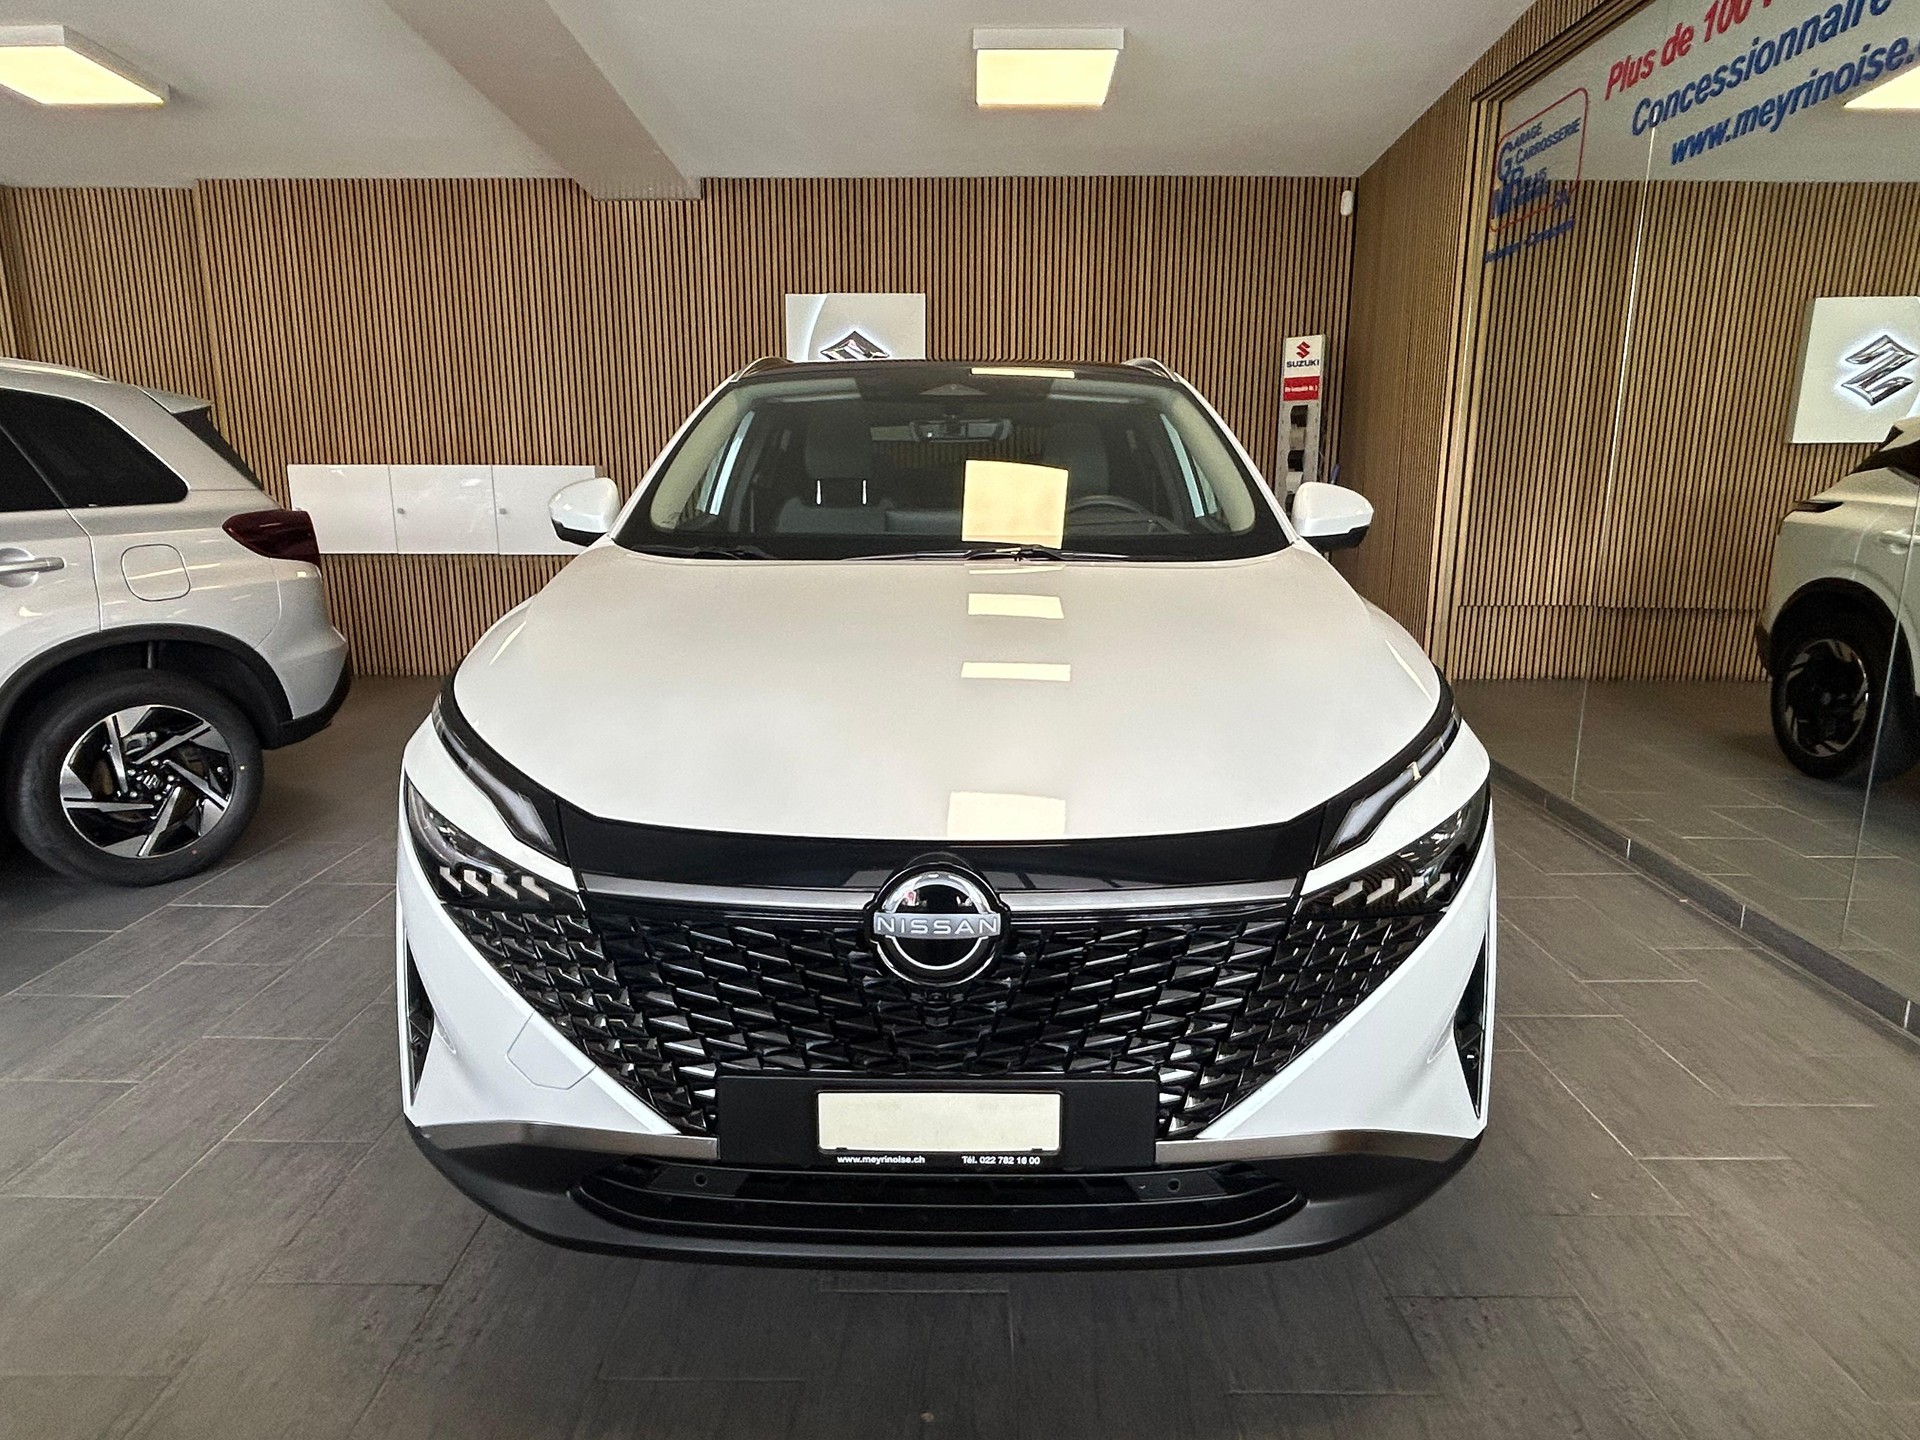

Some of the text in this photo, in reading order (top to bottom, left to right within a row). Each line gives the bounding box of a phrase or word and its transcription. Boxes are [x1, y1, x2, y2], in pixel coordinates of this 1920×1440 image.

[1604, 0, 1752, 101] Plus de 100
[1670, 36, 1920, 166] www.meyrinoise.
[1286, 359, 1320, 368] SUZUKI
[876, 916, 998, 935] NISSAN
[836, 1155, 926, 1165] www.meyrinoise.ch
[979, 1156, 997, 1165] 022
[1028, 1156, 1041, 1165] 00
